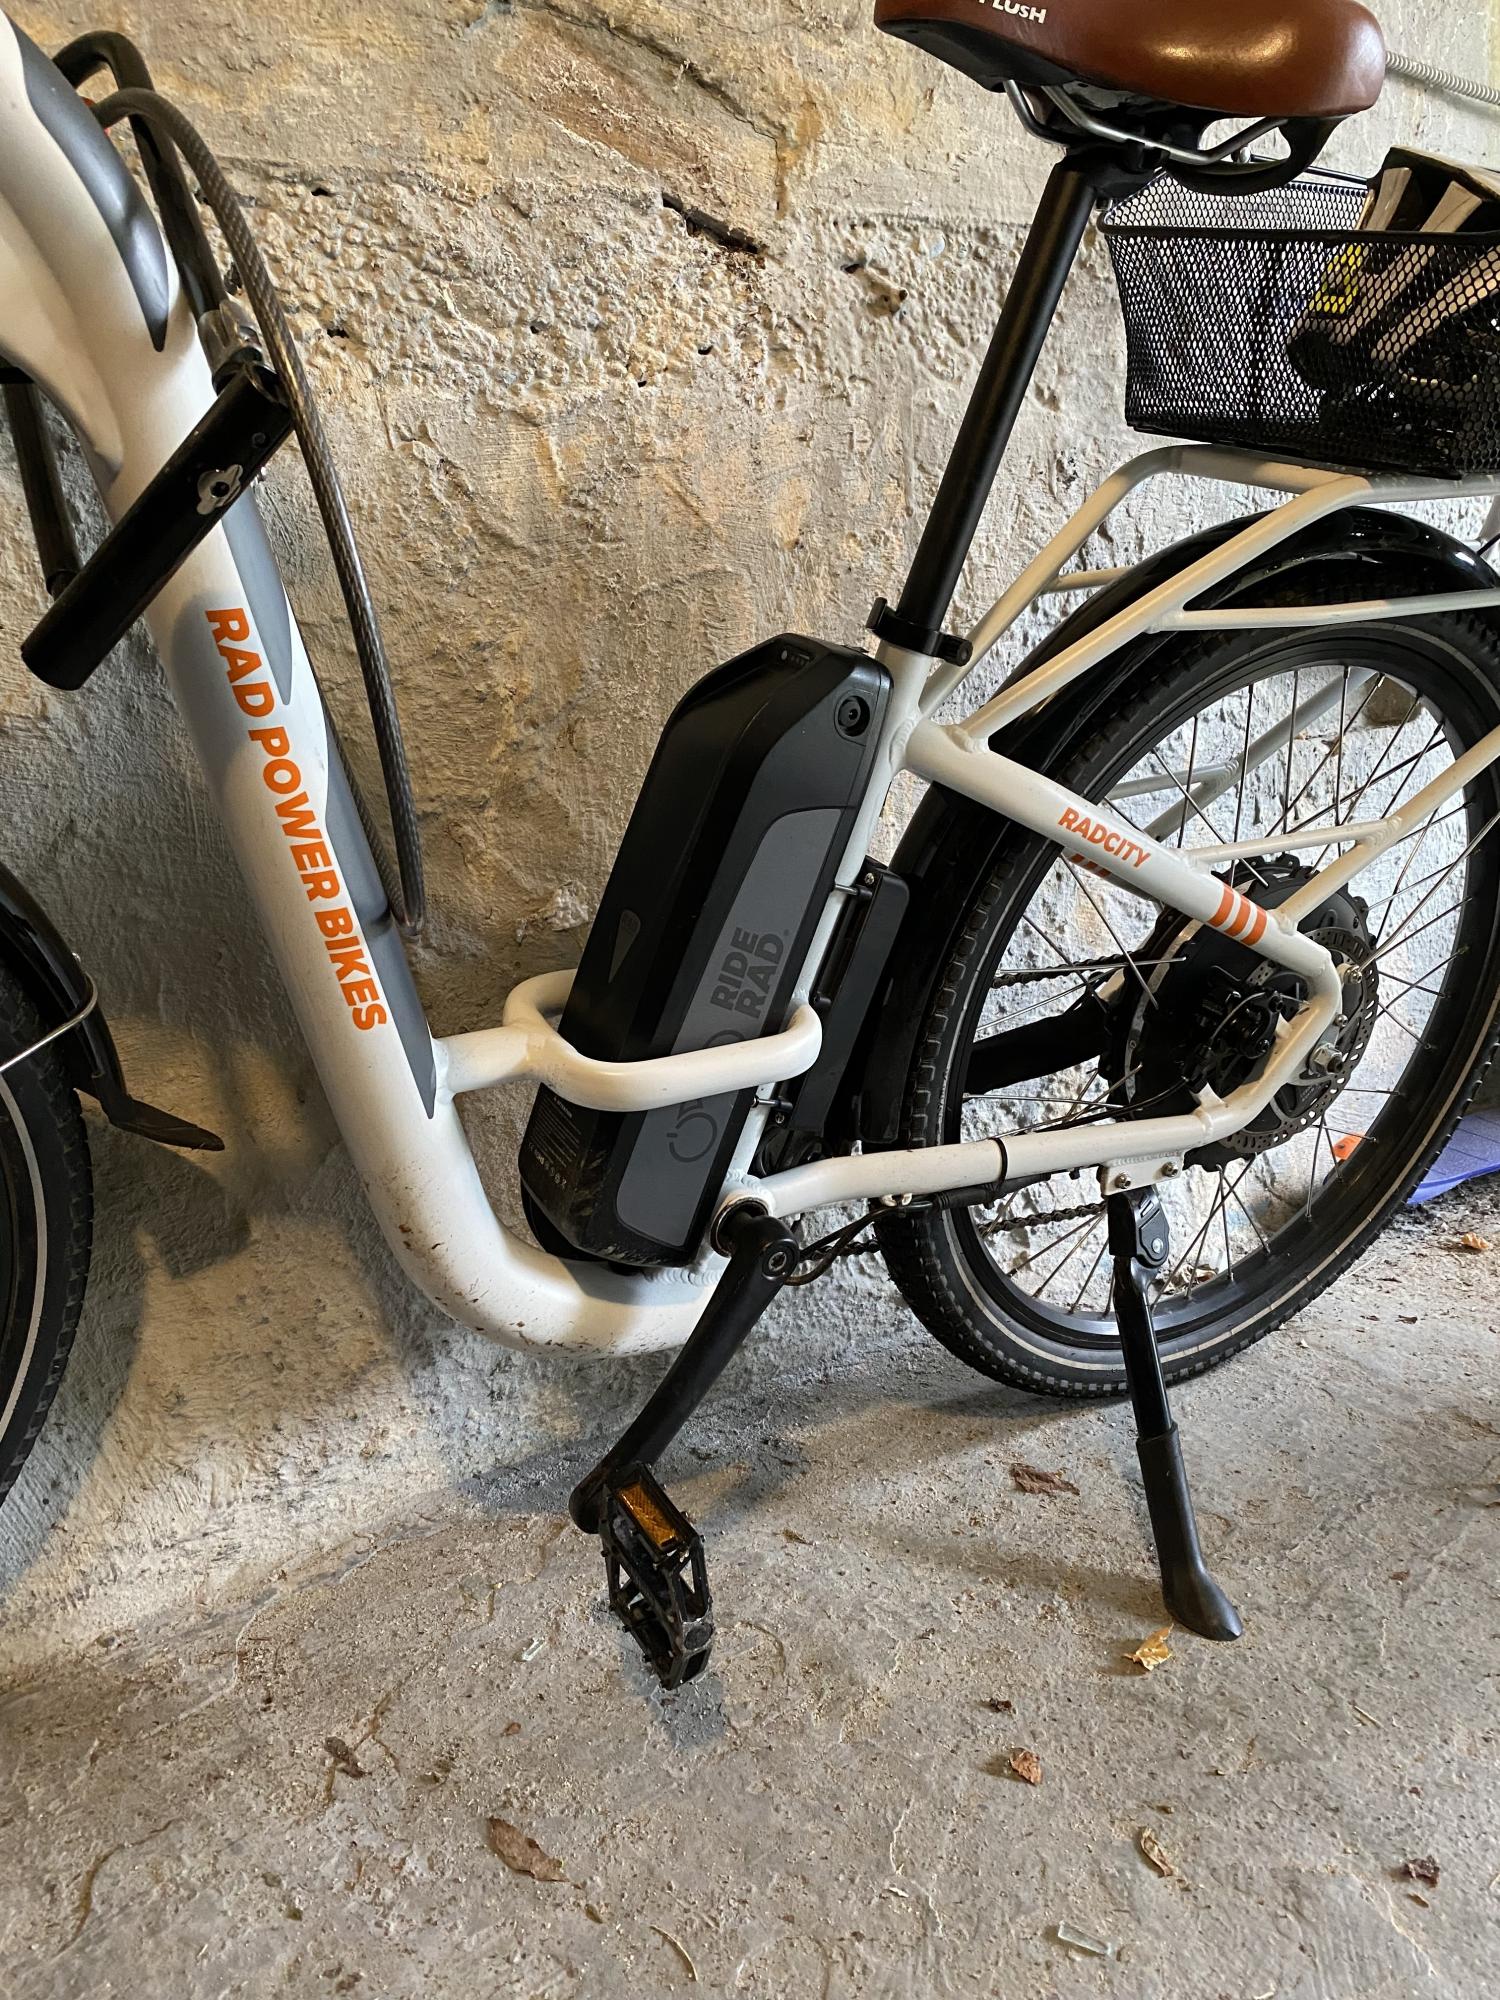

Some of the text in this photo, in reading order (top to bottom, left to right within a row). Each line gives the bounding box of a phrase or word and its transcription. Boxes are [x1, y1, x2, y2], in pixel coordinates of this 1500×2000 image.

[978, 0, 1047, 24] LUSH
[205, 607, 388, 1031] RAD POWER BIKES
[1057, 807, 1151, 869] RADCITY
[709, 926, 759, 1011] RIDE
